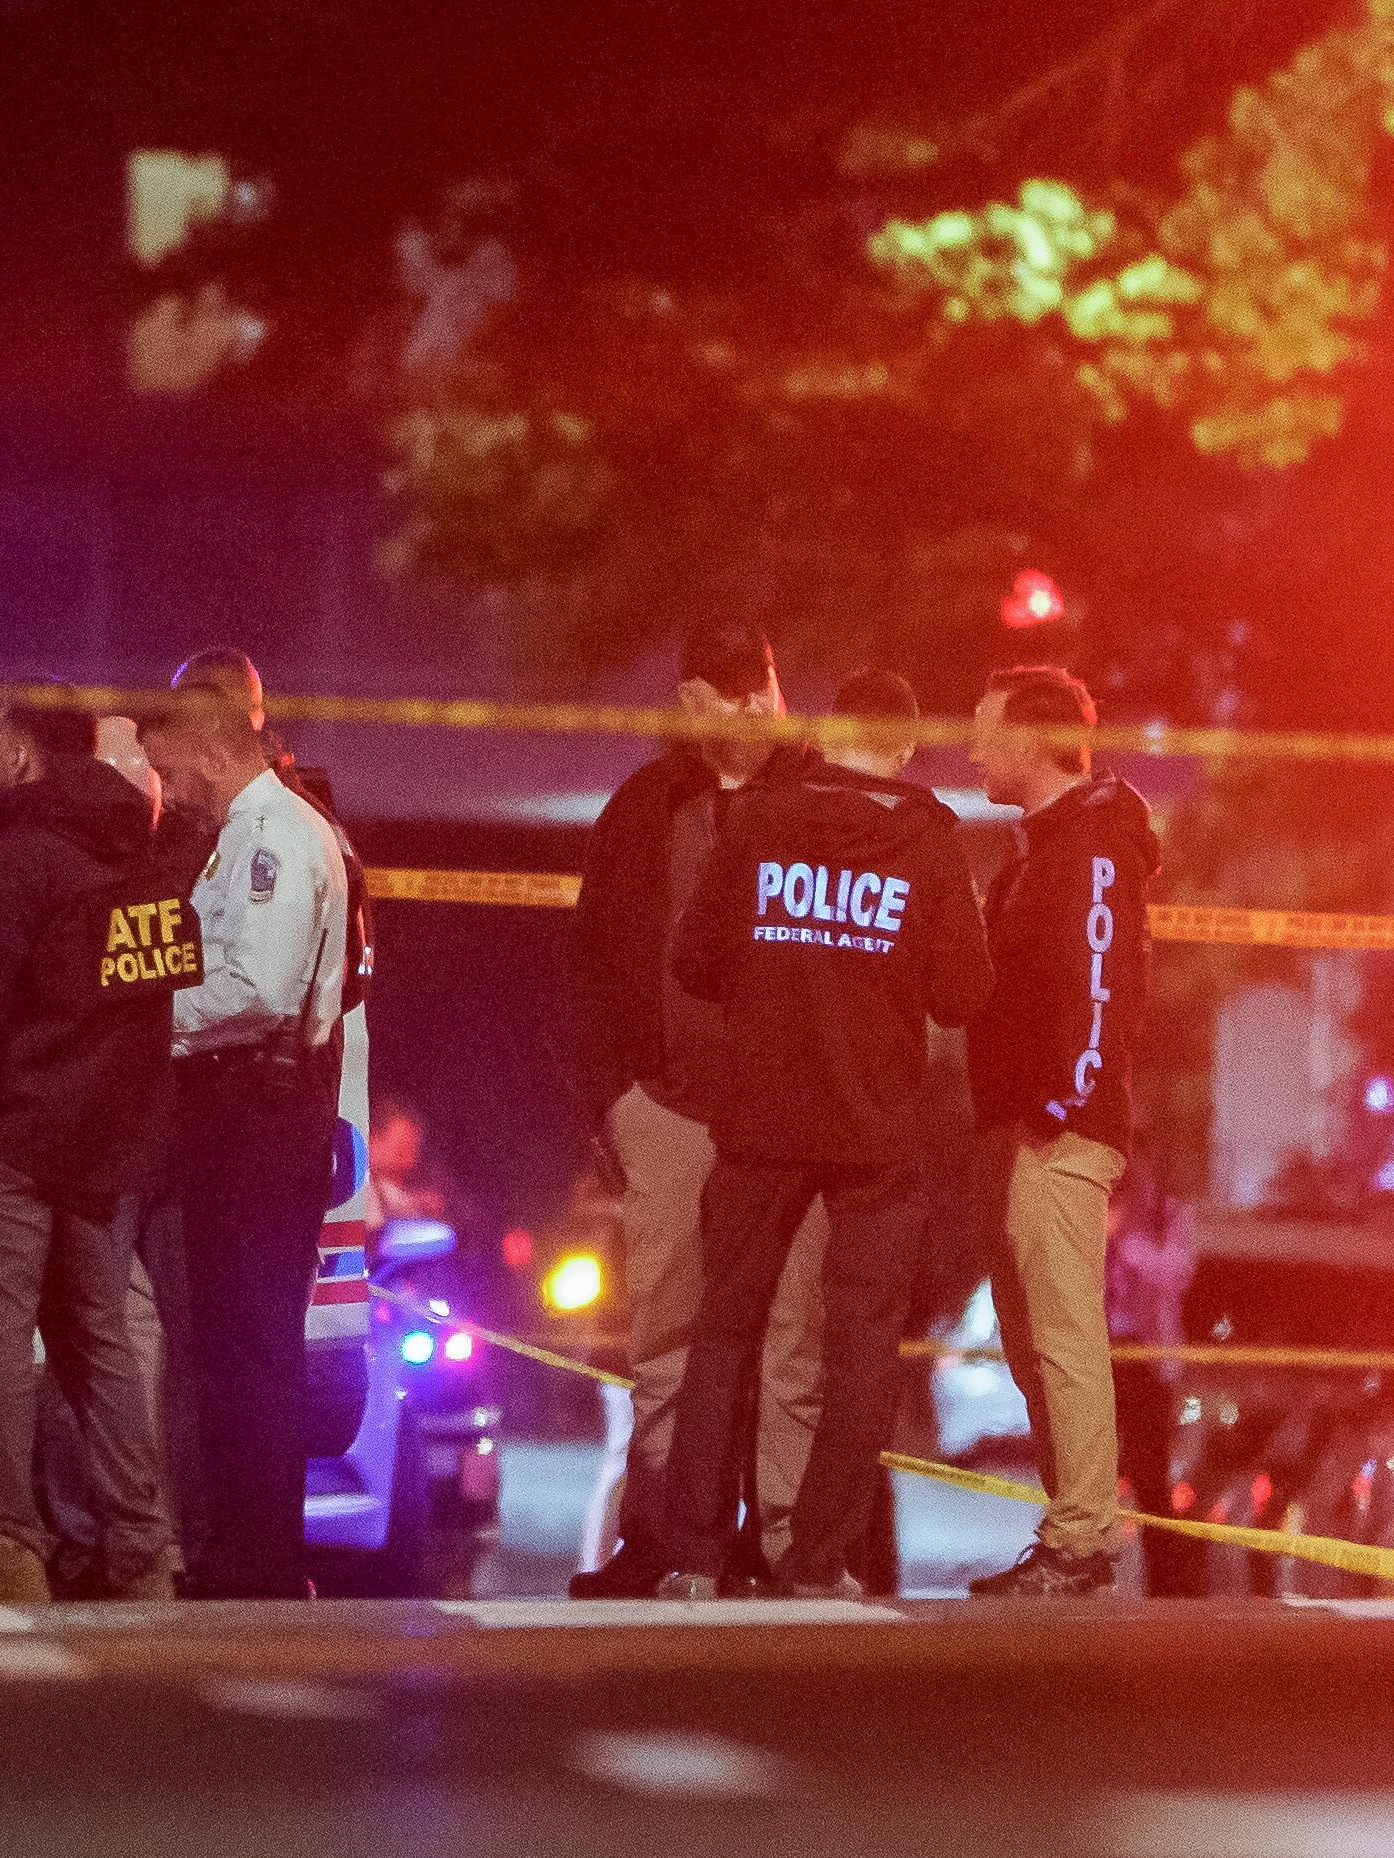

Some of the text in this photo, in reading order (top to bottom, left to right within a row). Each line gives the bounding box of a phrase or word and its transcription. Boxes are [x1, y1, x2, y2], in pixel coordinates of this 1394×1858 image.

[757, 862, 910, 932] POLICE
[107, 899, 182, 952] ATF
[753, 926, 834, 946] FEDERAL
[101, 943, 197, 986] POLICE
